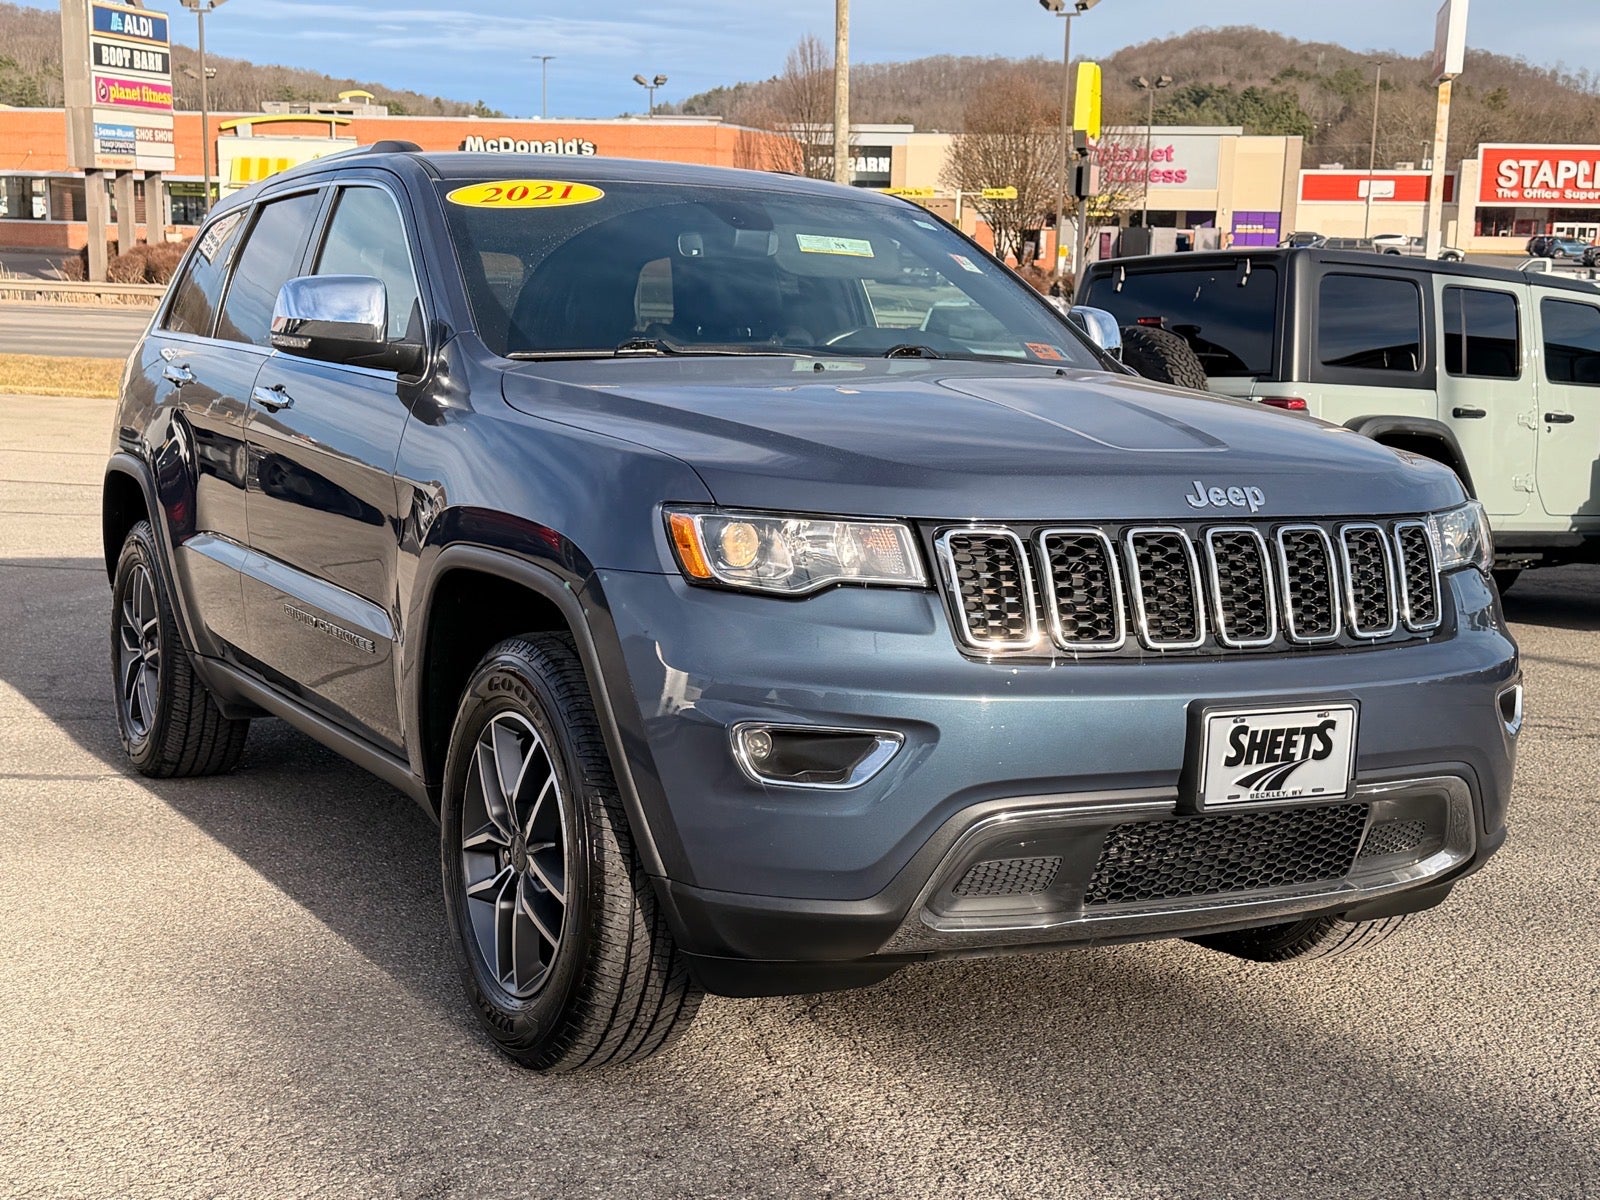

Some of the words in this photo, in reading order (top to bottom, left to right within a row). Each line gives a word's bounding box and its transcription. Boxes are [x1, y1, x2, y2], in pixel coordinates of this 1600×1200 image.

[124, 14, 153, 38] ALDI
[101, 45, 131, 68] BOOT
[133, 49, 163, 72] BARN
[109, 82, 140, 102] planet
[142, 86, 172, 105] fitness
[136, 128, 154, 141] SHOE
[154, 130, 173, 143] SHOW
[465, 135, 595, 156] McDonald's
[1098, 143, 1175, 164] planet
[481, 184, 574, 203] 2021
[1496, 188, 1519, 199] The
[1523, 188, 1560, 199] Office
[1185, 480, 1266, 513] Jeep
[318, 617, 376, 654] CHEROKEE
[1224, 719, 1337, 768] SHEETS
